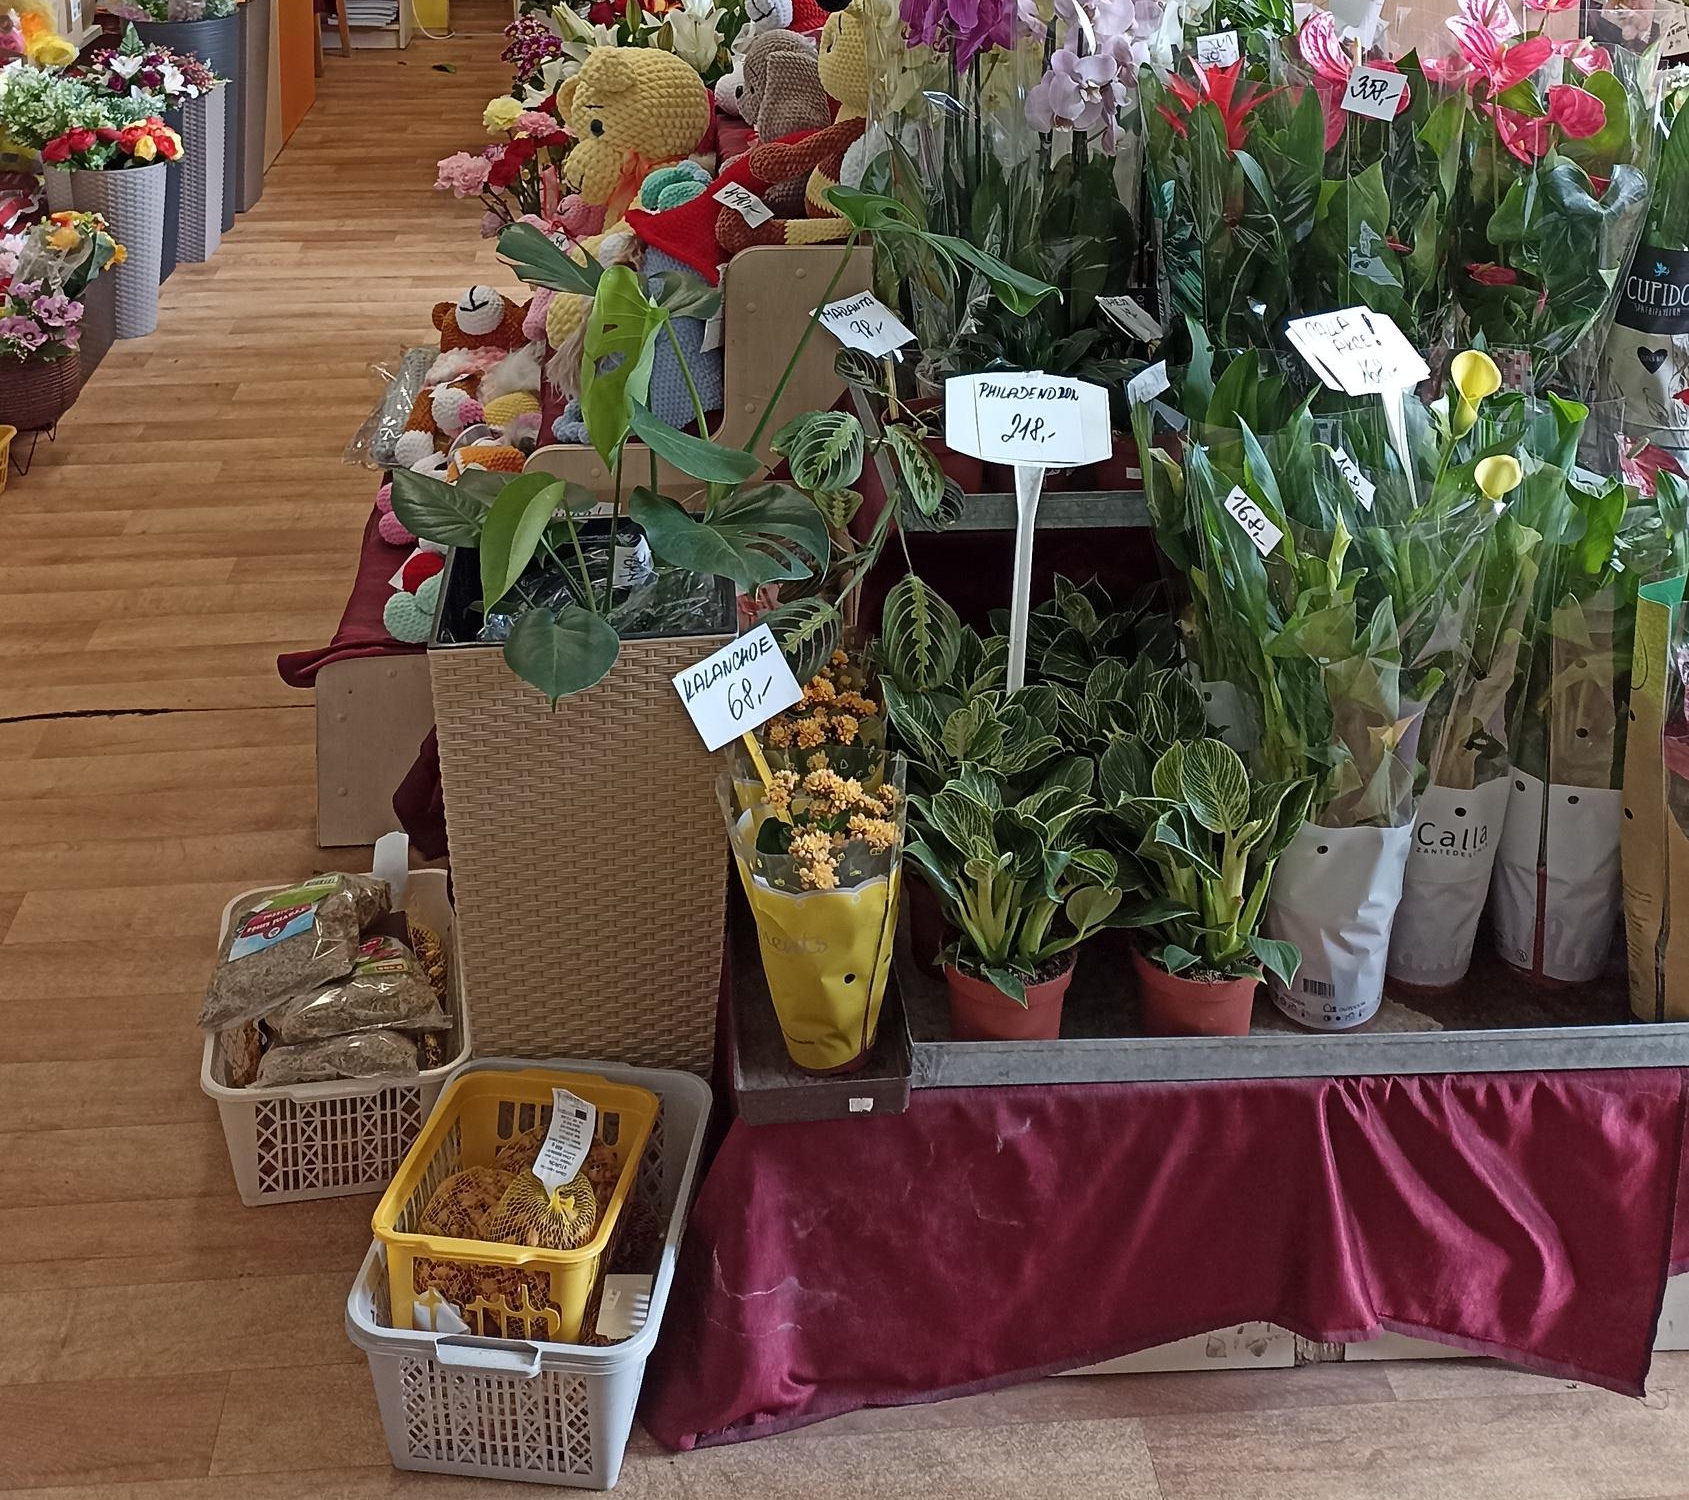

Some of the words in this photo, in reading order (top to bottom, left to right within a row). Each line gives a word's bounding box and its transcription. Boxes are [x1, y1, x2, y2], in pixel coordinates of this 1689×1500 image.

[821, 296, 875, 322] MARANTA
[978, 382, 1079, 401] PHILADENDRON
[683, 636, 773, 703] KALANCHOE
[1417, 822, 1487, 851] Calla
